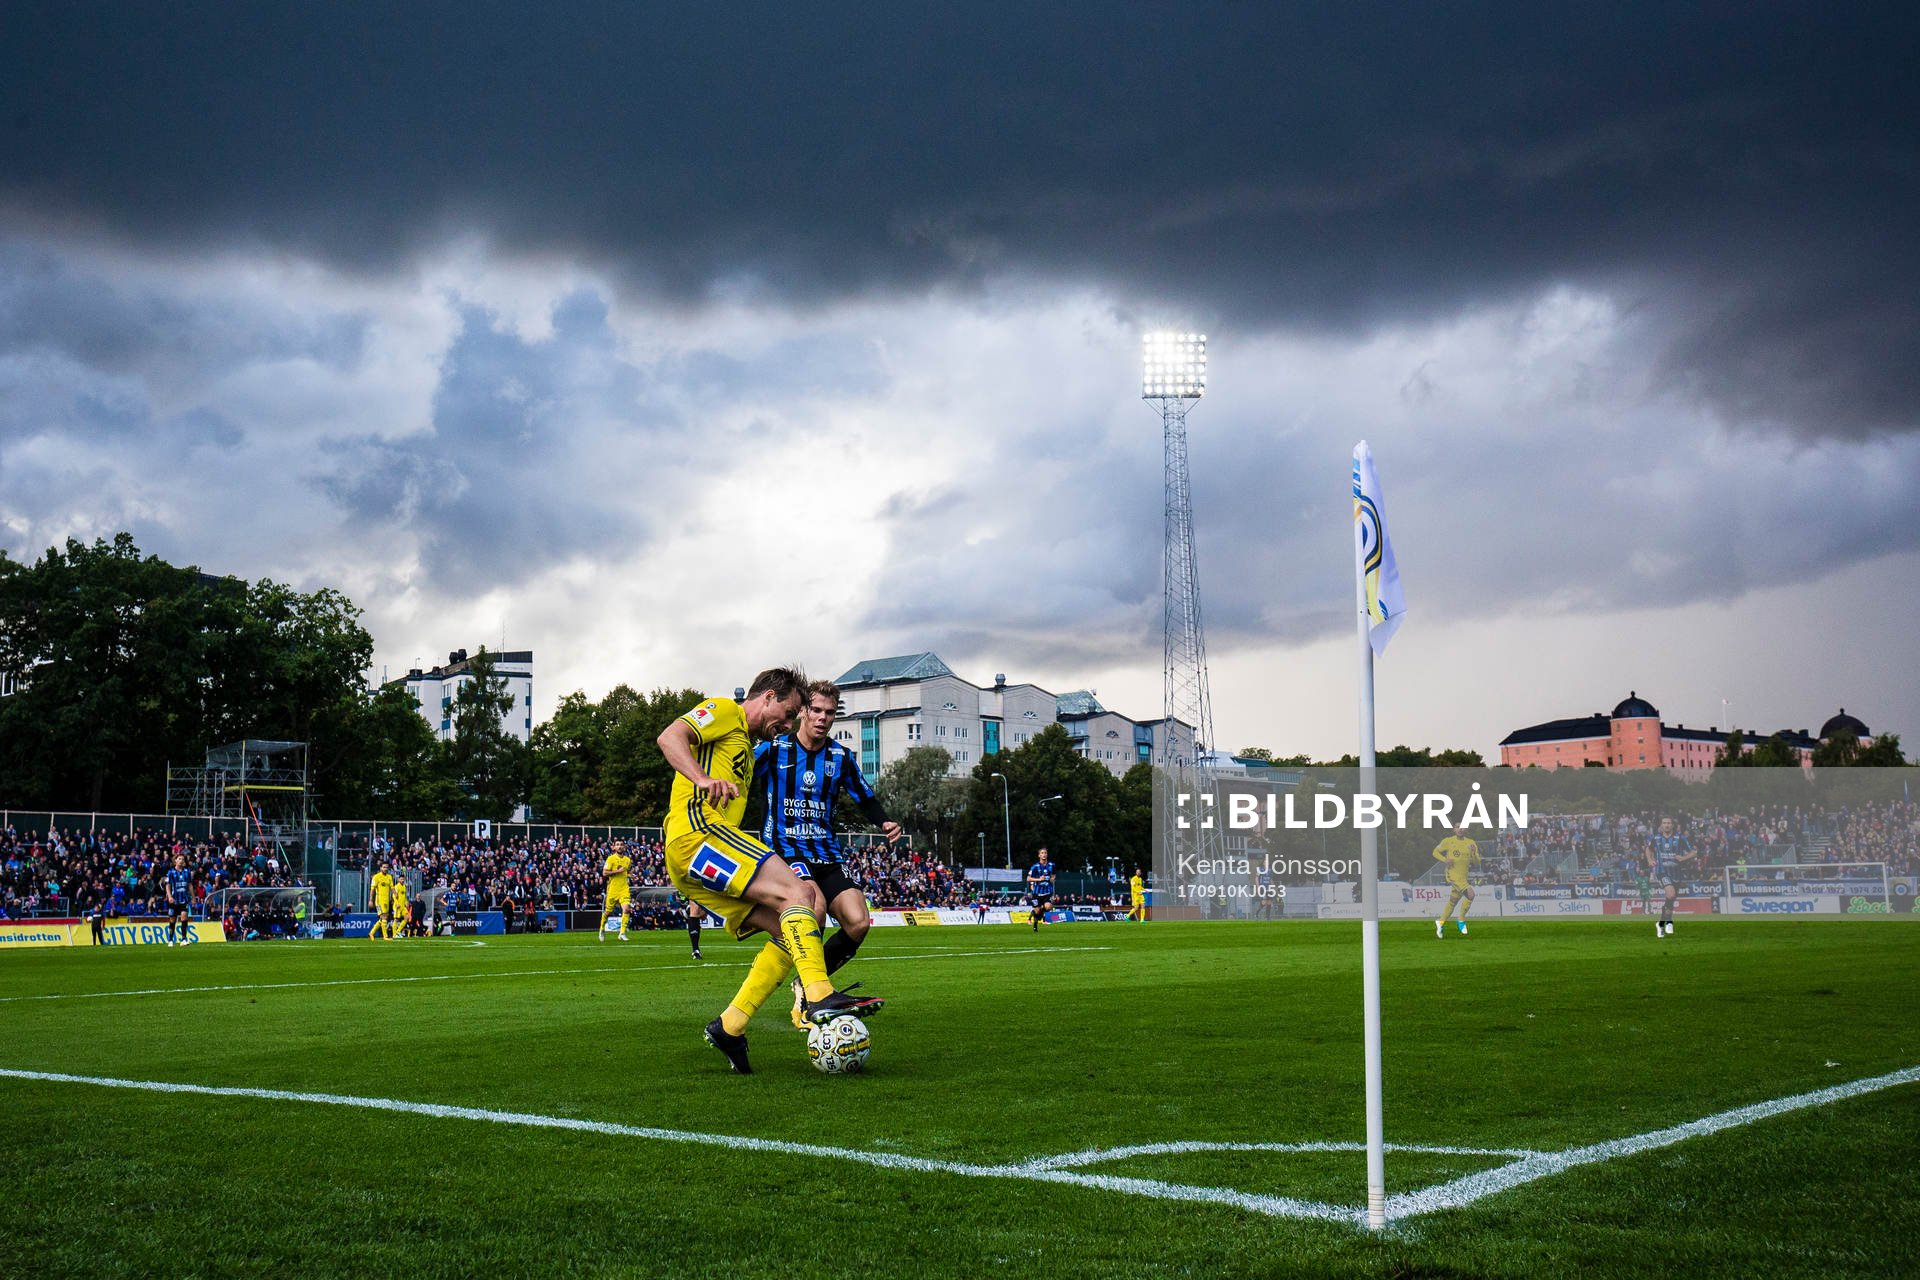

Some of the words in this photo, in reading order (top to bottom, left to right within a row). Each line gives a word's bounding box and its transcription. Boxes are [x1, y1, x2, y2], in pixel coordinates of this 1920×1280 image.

[783, 798, 806, 807] BYGG
[478, 822, 486, 834] P
[1415, 888, 1441, 901] Kph
[1575, 884, 1610, 896] brand
[1692, 884, 1722, 893] brand
[1514, 902, 1545, 913] Sallén
[1558, 901, 1591, 913] Sallén
[1741, 898, 1814, 913] Swegon
[102, 926, 137, 945] CITY
